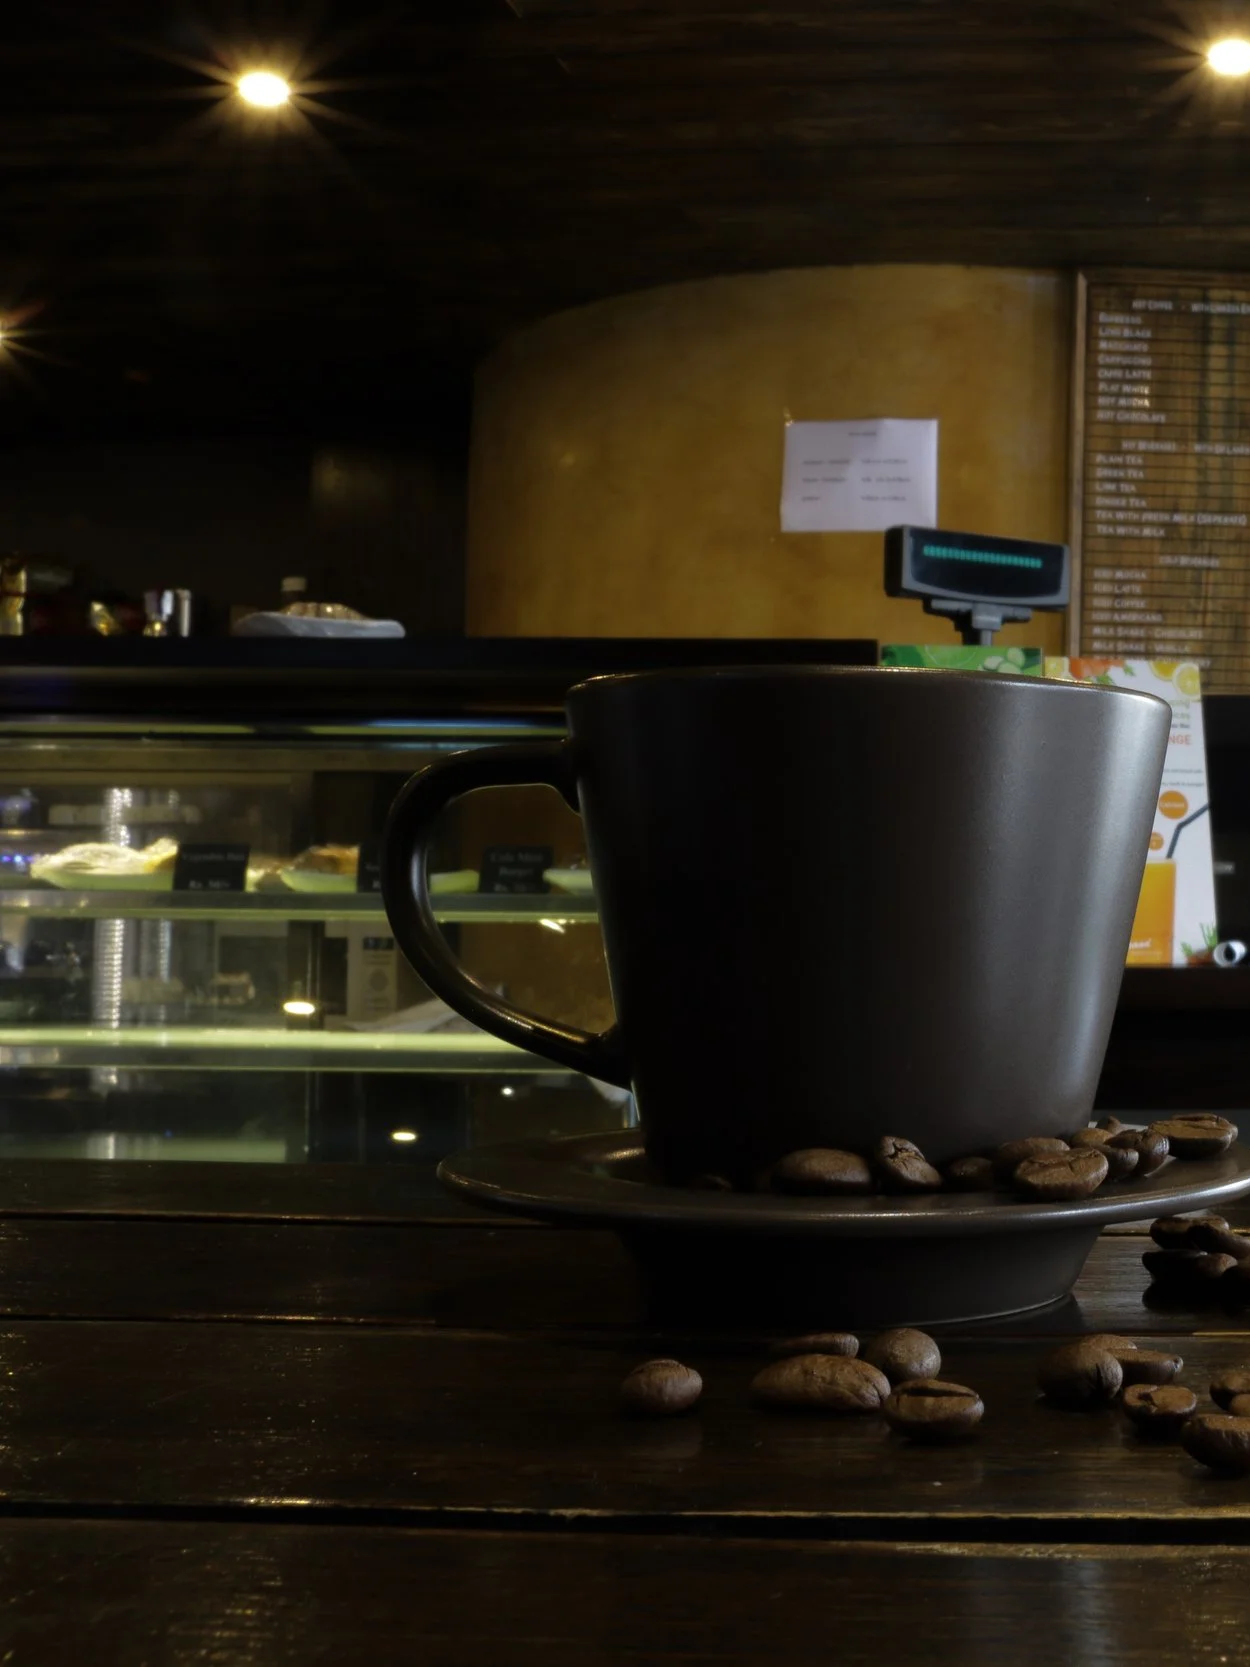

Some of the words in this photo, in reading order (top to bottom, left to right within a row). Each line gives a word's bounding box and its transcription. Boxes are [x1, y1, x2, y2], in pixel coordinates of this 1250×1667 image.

[1098, 327, 1122, 337] LONG
[1123, 328, 1151, 338] BLACK
[1125, 370, 1152, 380] LATTE
[1125, 456, 1143, 465] TEA
[1127, 469, 1144, 478] TEA
[1120, 483, 1136, 493] TEA
[1129, 498, 1146, 507] TEA
[1096, 511, 1113, 519] TEA
[1116, 511, 1140, 520] WITH
[1097, 524, 1114, 534] TEA
[1116, 525, 1140, 535] WITH
[1142, 526, 1165, 536] MILK
[1115, 570, 1146, 580] MOCHA
[1114, 584, 1142, 594] LATTE
[1114, 599, 1146, 608] COFFEE
[1092, 627, 1114, 636] MILK
[1116, 628, 1145, 637] SHAKE
[1154, 628, 1203, 639] CHOCOLATE
[1092, 641, 1114, 650] MILK
[1116, 642, 1145, 652] SHAKE
[1154, 642, 1190, 653] VANILLA
